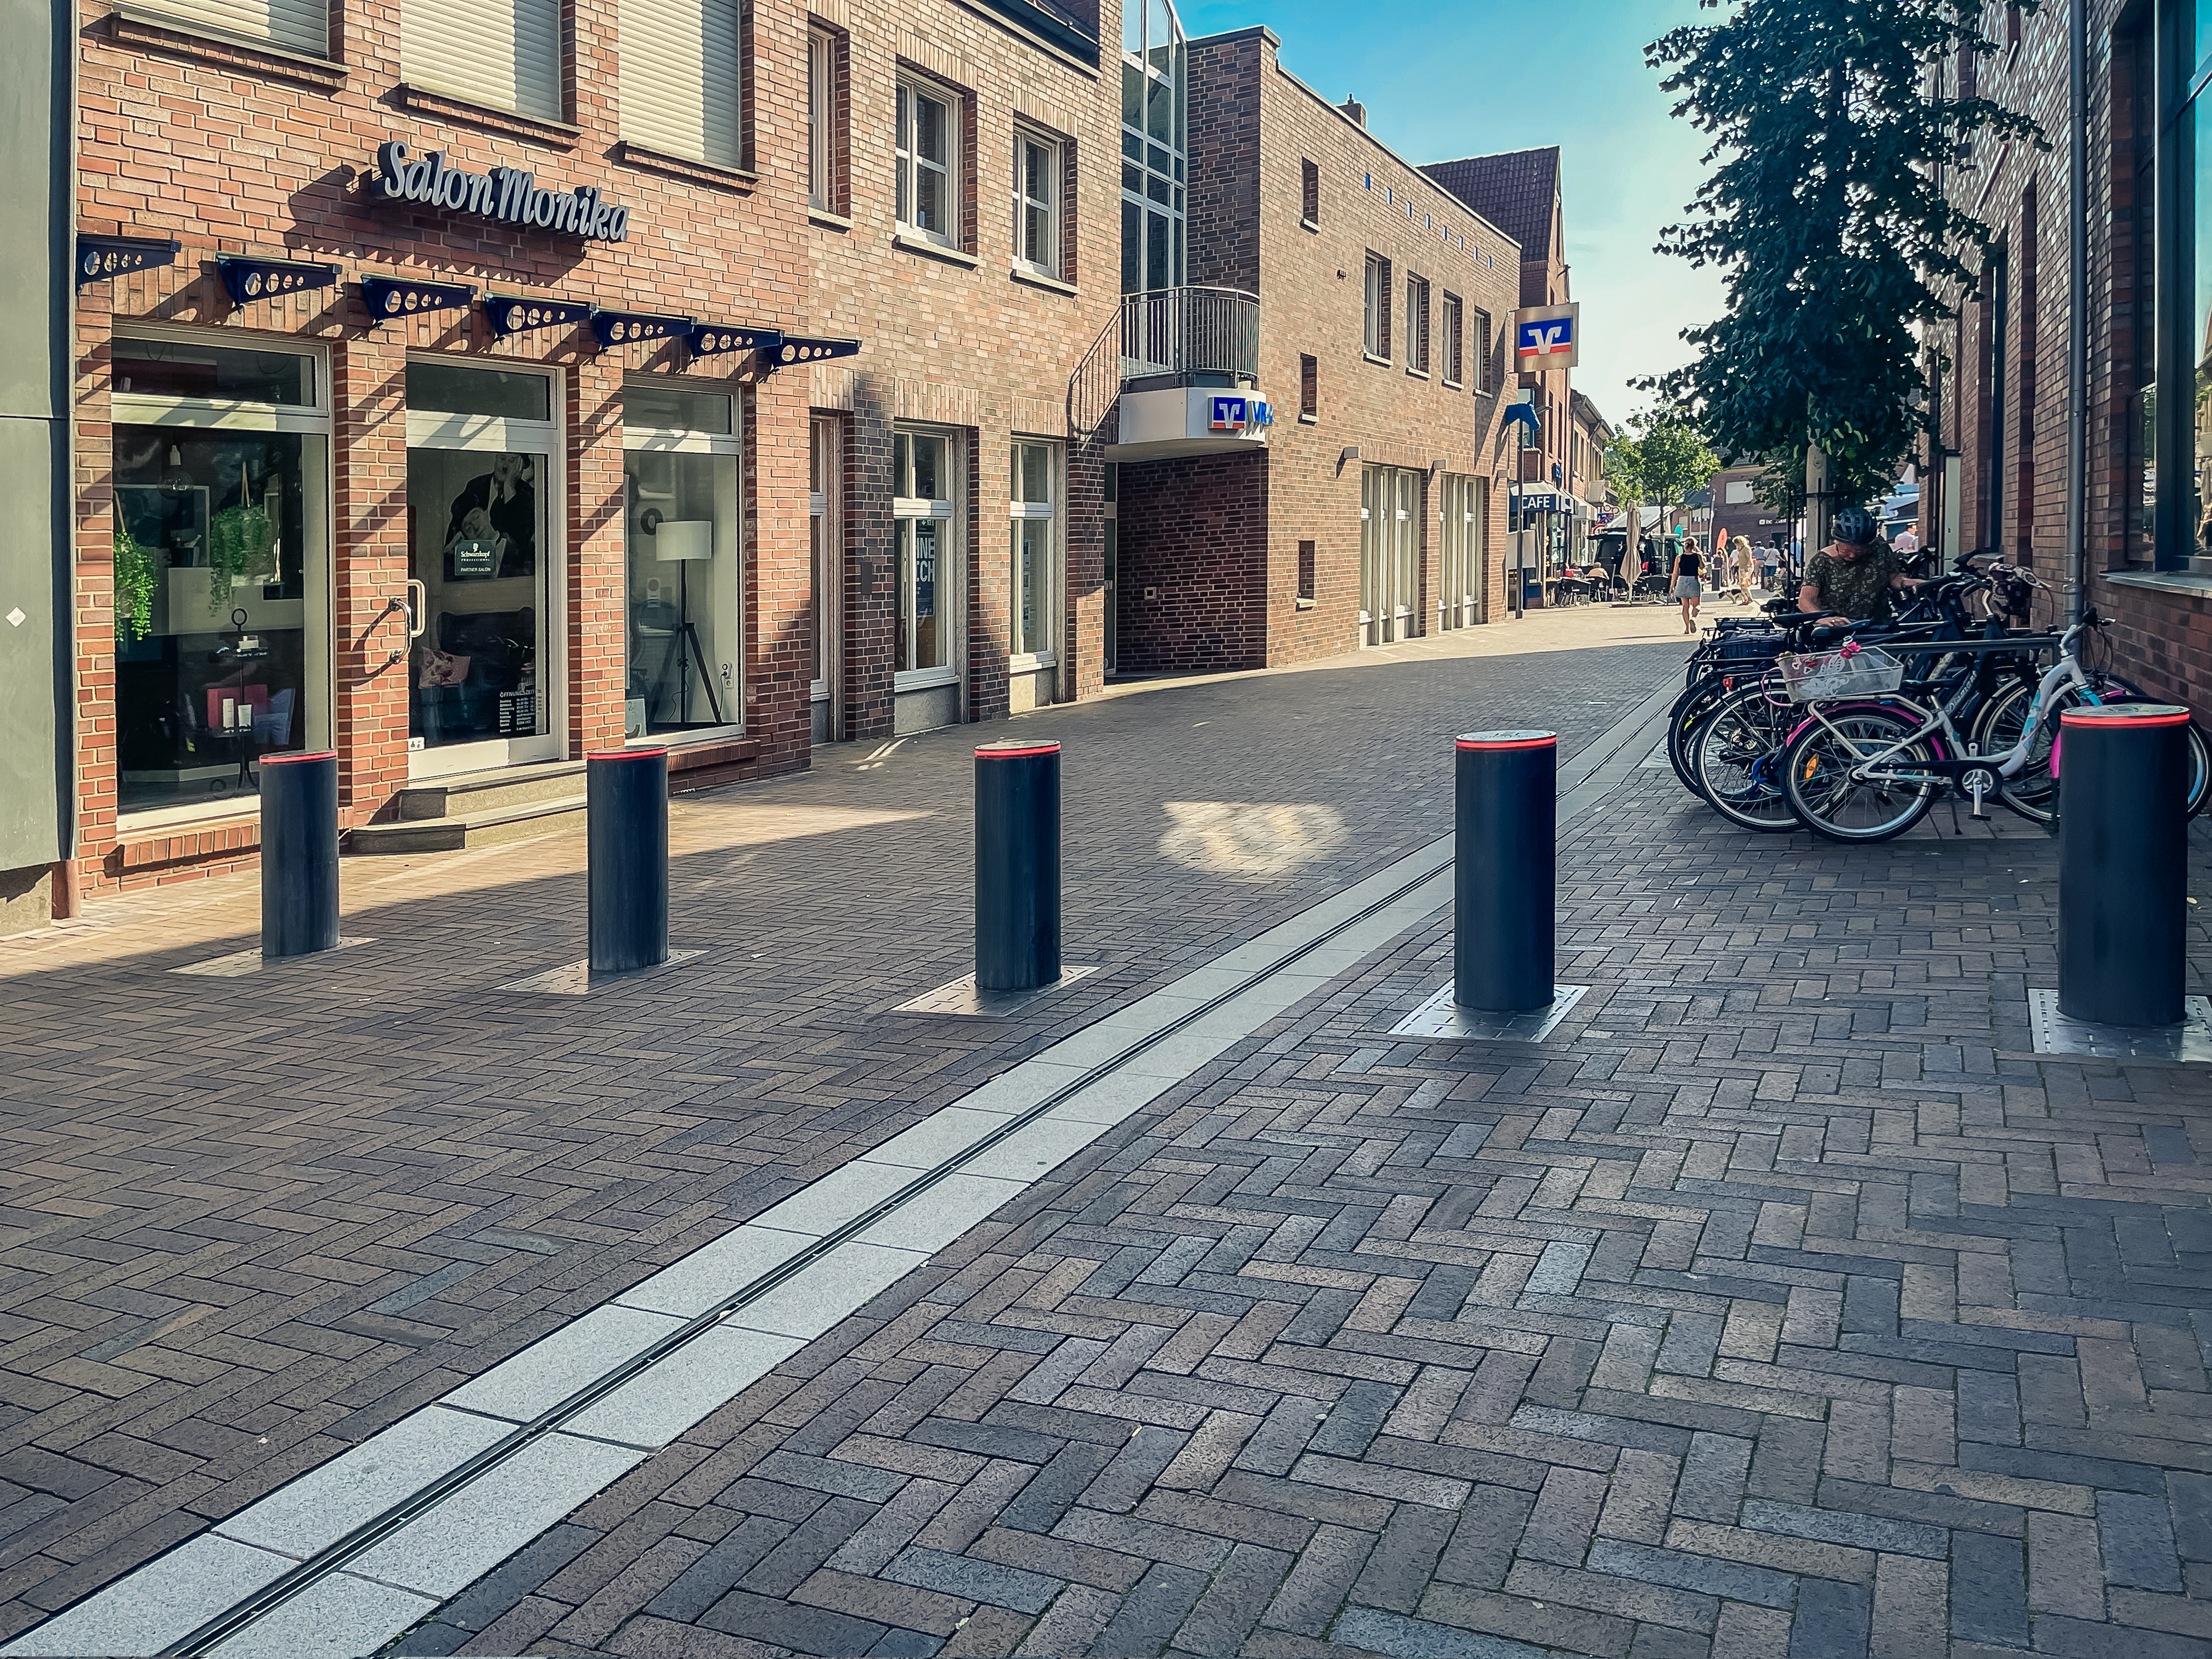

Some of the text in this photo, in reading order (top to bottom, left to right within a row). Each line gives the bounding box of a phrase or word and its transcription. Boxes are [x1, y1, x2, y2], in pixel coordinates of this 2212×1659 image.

[382, 140, 630, 242] Salon Monika
[1522, 496, 1550, 509] CAFE
